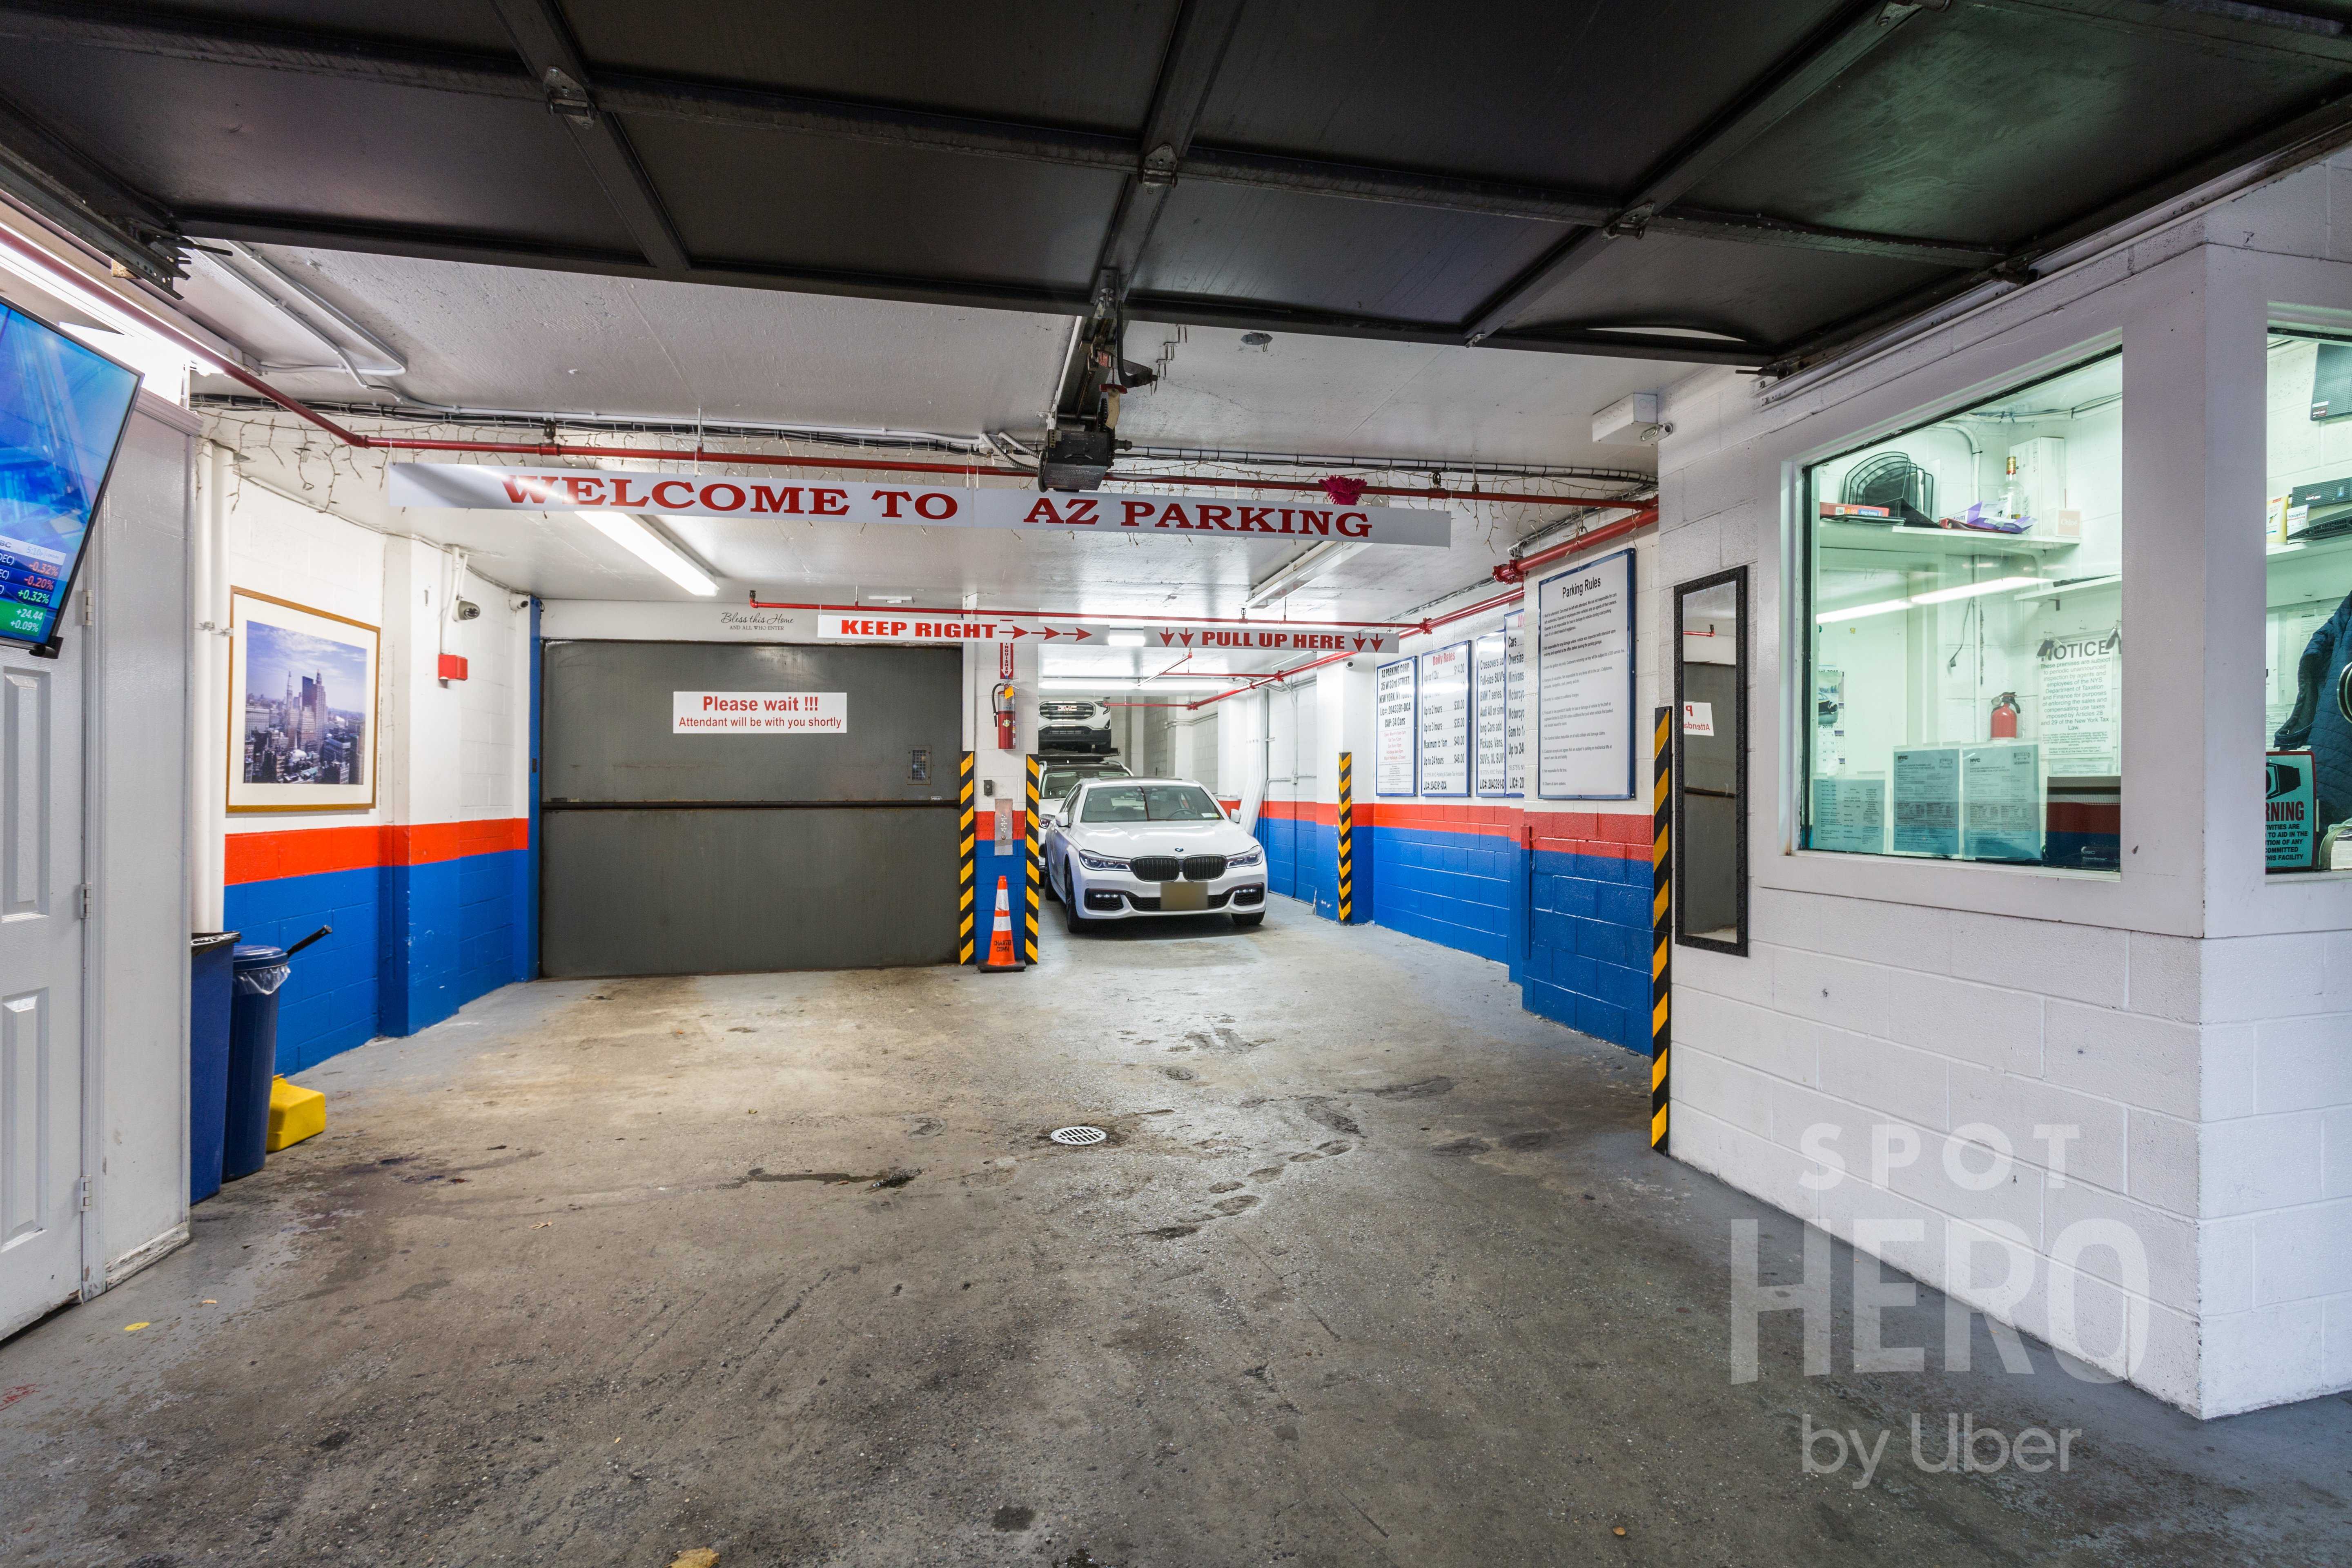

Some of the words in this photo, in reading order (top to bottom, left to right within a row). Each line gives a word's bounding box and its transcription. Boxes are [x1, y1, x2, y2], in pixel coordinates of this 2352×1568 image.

[501, 475, 850, 516] WELCOME
[871, 490, 958, 520] TO
[1024, 497, 1098, 524] AZ
[1121, 501, 1373, 537] PARKING
[0, 553, 14, 566] DEC)
[29, 561, 59, 576] -0.32%
[24, 576, 53, 590] -0.20%
[1562, 584, 1583, 599] Parking
[1585, 577, 1601, 591] Rules
[18, 590, 49, 604] +0.32%
[17, 608, 43, 620] +24.44
[721, 612, 747, 623] Bless
[750, 612, 766, 623] this
[767, 614, 794, 624] Home
[11, 619, 39, 632] +0.09%
[841, 620, 907, 636] KEEP
[915, 622, 997, 638] RIGHT
[1202, 631, 1253, 646] PULL
[1259, 633, 1287, 647] UP
[1293, 634, 1345, 649] HERE
[2041, 640, 2109, 662] OTICE
[1433, 655, 1443, 666] Daily
[1443, 652, 1455, 664] Rates
[1480, 658, 1499, 670] Crossovers
[1508, 652, 1524, 666] Oversize
[1382, 669, 1385, 678] AZ
[1386, 665, 1399, 677] PARKING
[1508, 670, 1524, 683] Minivans
[1381, 682, 1385, 691] 35
[1385, 681, 1389, 689] W
[1480, 675, 1494, 686] Full-size
[1489, 689, 1491, 700] 7
[703, 696, 758, 711] Please
[764, 697, 799, 711] wait
[804, 697, 818, 711] !!!
[1424, 707, 1428, 717] Up
[1428, 706, 1431, 715] to
[1432, 705, 1434, 714] 2
[1454, 699, 1465, 710] $30.00
[1488, 706, 1492, 716] A8
[1493, 707, 1496, 715] or
[679, 717, 727, 726] Attendant
[730, 717, 746, 726] will
[751, 717, 761, 726] be
[765, 717, 784, 726] with
[788, 719, 805, 728] you
[808, 717, 841, 728] shortly
[1392, 718, 1396, 727] 34
[1424, 723, 1428, 734] Up
[1428, 723, 1431, 731] to
[1432, 722, 1434, 731] 3
[1454, 717, 1465, 728] $35.00
[1517, 726, 1521, 736] to
[1424, 739, 1437, 749] Maximum
[1437, 738, 1441, 747] to
[1454, 735, 1465, 746] $40.00
[1508, 743, 1513, 758] Up
[1514, 743, 1518, 754] to
[1424, 757, 1428, 767] Up
[1428, 757, 1431, 765] to
[1432, 756, 1435, 765] 24
[1436, 756, 1444, 764] hours
[1454, 754, 1465, 764] $46.00
[1491, 754, 1495, 764] XL
[1488, 779, 1504, 789] 2043391-D
[2265, 801, 2304, 822] RNING
